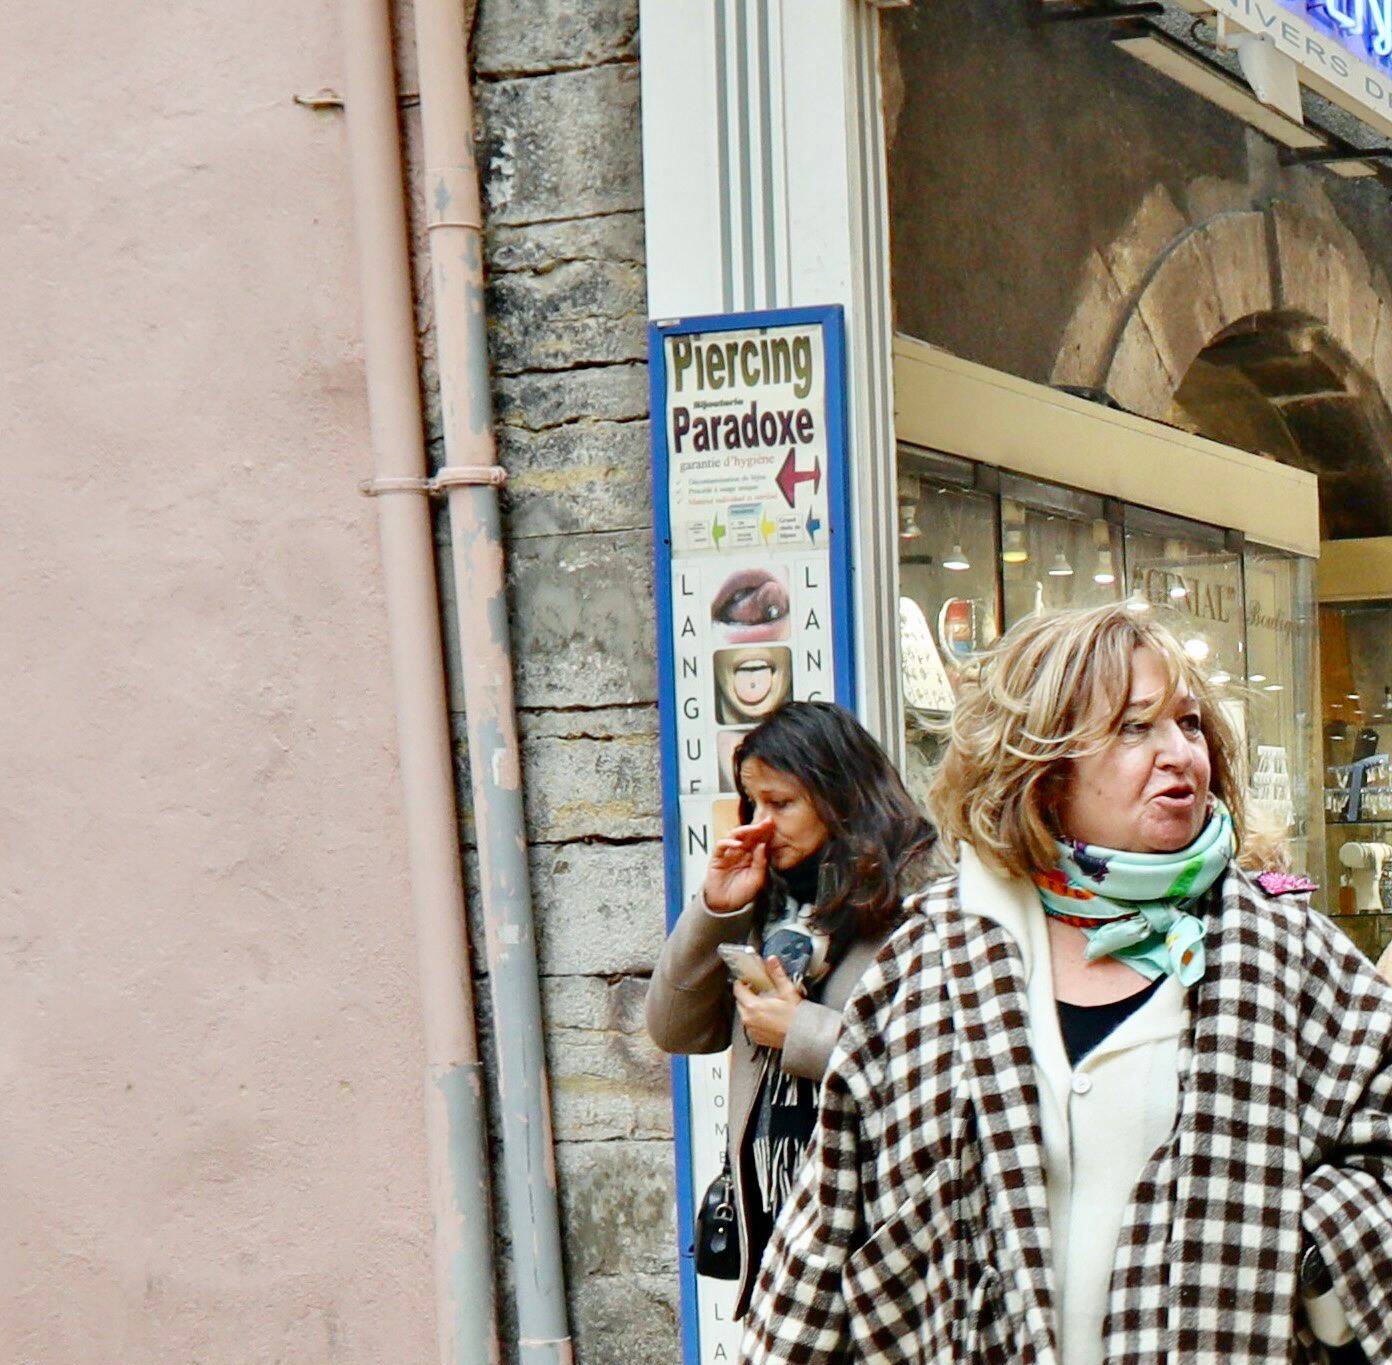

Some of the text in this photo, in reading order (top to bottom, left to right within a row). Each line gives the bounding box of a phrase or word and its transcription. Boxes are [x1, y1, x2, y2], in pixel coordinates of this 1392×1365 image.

[1229, 0, 1349, 78] IVERS
[670, 328, 813, 399] Piercing
[672, 401, 815, 454] Paradoxe
[679, 459, 720, 472] garantie
